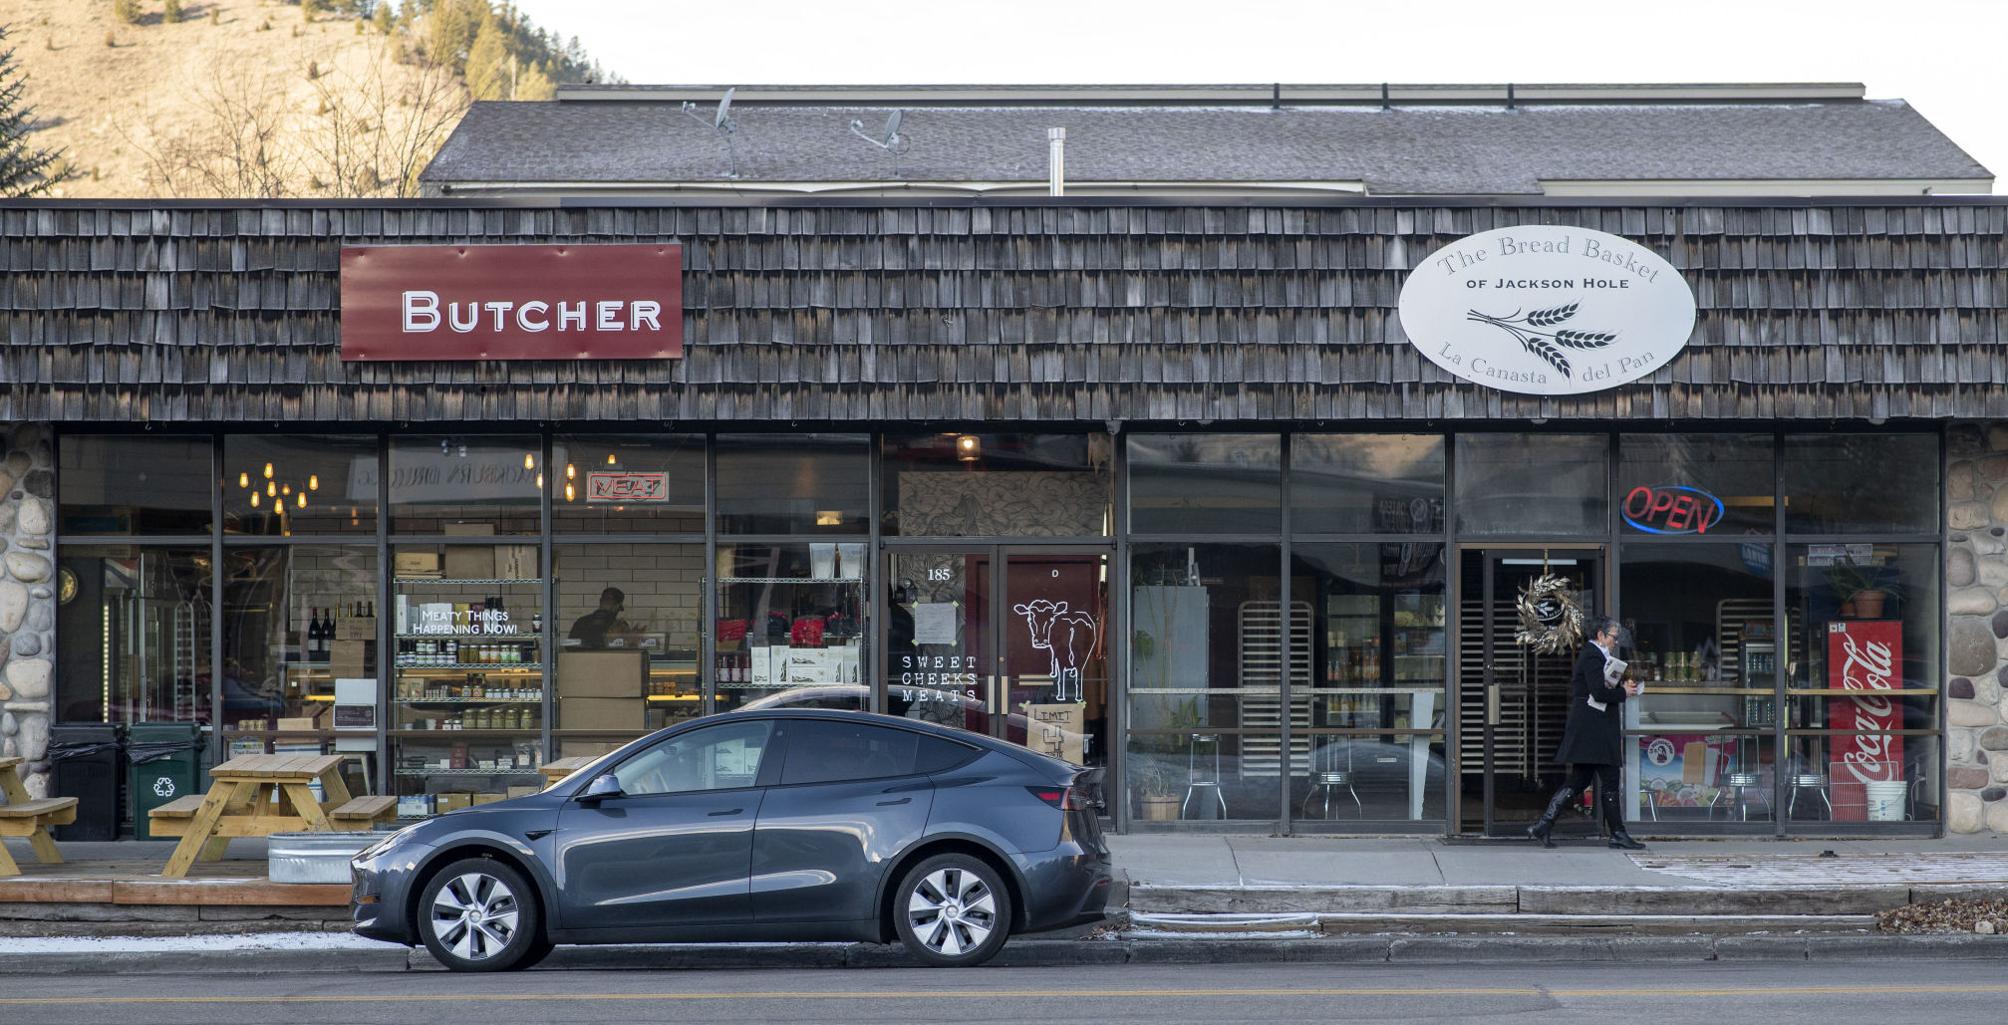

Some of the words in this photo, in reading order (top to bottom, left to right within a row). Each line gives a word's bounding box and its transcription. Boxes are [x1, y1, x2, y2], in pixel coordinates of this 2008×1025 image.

[1437, 248, 1488, 276] The
[1499, 235, 1570, 257] Bread
[1582, 238, 1659, 284] Basket
[1495, 278, 1574, 289] JACKSON
[1583, 278, 1629, 289] HOLE
[402, 290, 662, 333] BUTCHER
[1437, 342, 1462, 366] La
[1470, 356, 1547, 384] Canasta
[1582, 363, 1611, 383] del
[1620, 350, 1655, 377] Pan
[594, 479, 661, 497] MEAT
[1625, 486, 1715, 534] OPEN
[927, 568, 950, 581] 185
[422, 610, 461, 622] MEATY
[466, 610, 508, 622] THINGS
[413, 623, 479, 635] HAPPENING
[483, 623, 518, 635] NOW!
[902, 656, 976, 669] SWEET
[902, 673, 977, 685] CHEEKS
[902, 690, 976, 702] MEATS
[1843, 632, 1893, 785] Coca-Cola
